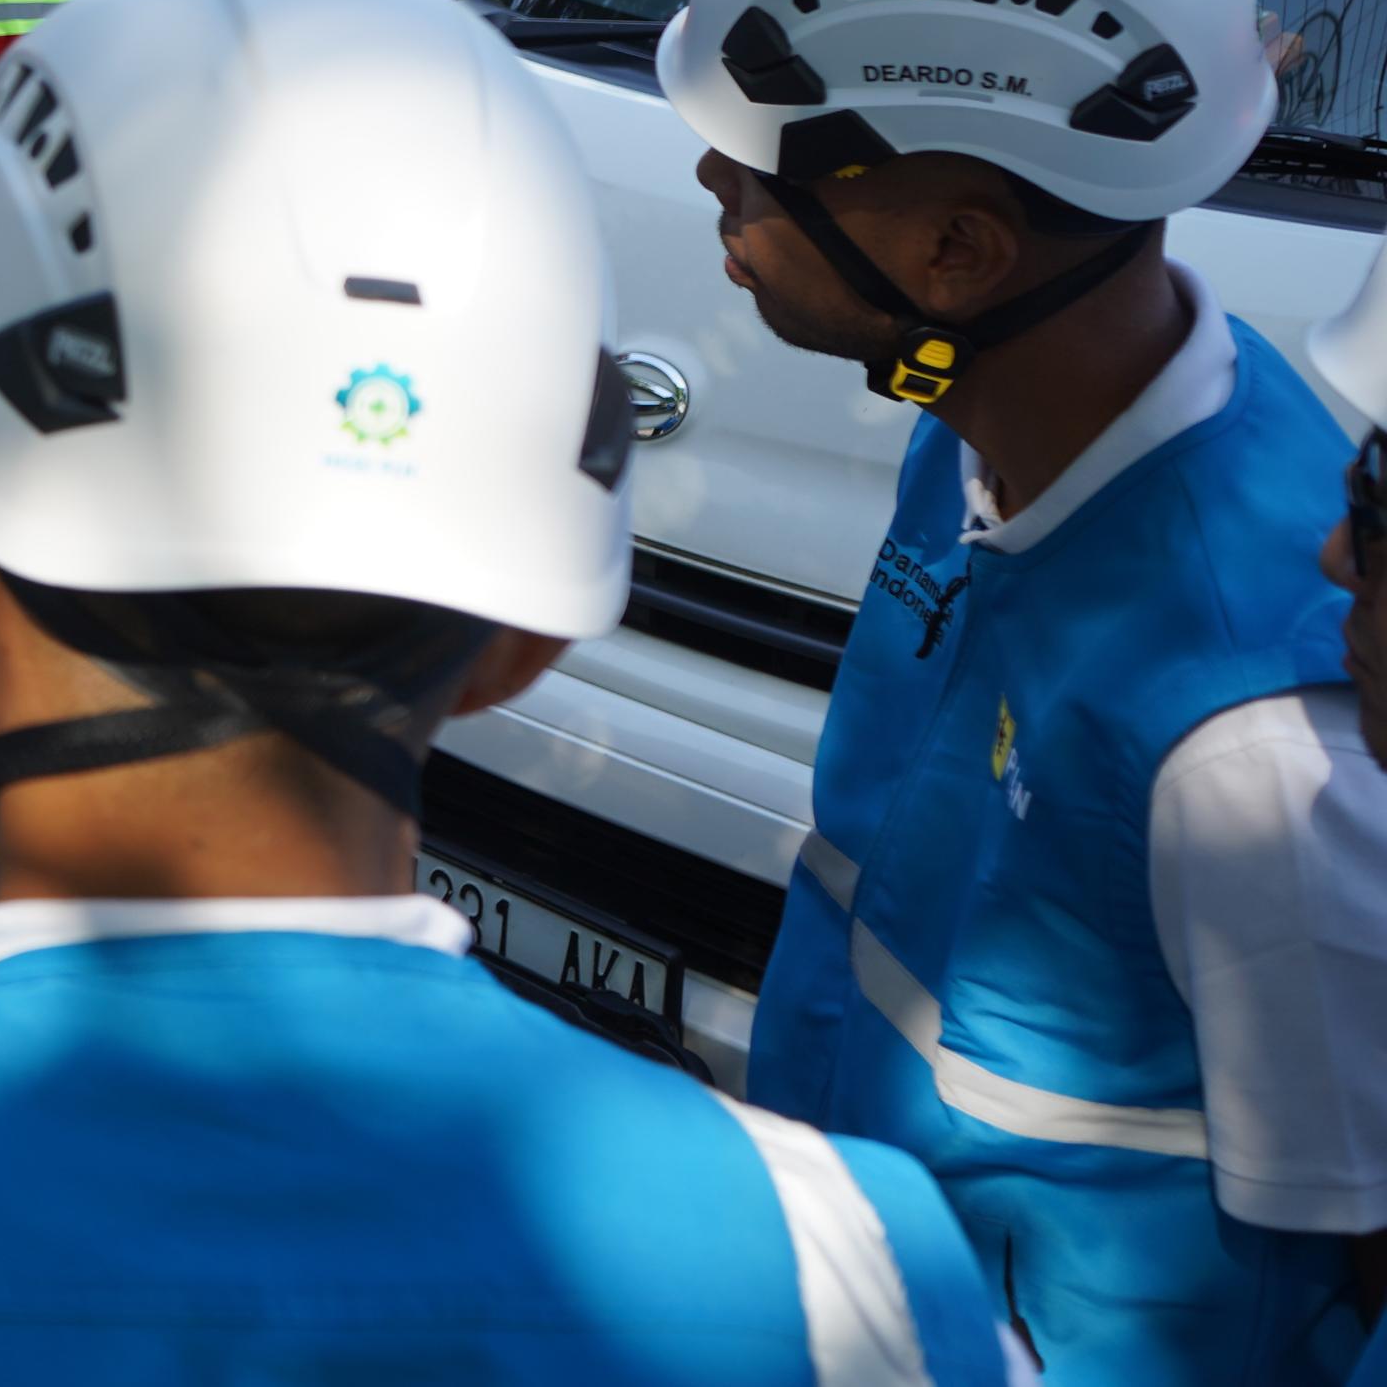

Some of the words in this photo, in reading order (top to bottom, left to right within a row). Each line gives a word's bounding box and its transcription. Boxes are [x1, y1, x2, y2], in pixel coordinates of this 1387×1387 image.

[863, 65, 973, 86] DEARDO
[981, 71, 1032, 96] S.M.
[560, 931, 645, 1007] AKA
